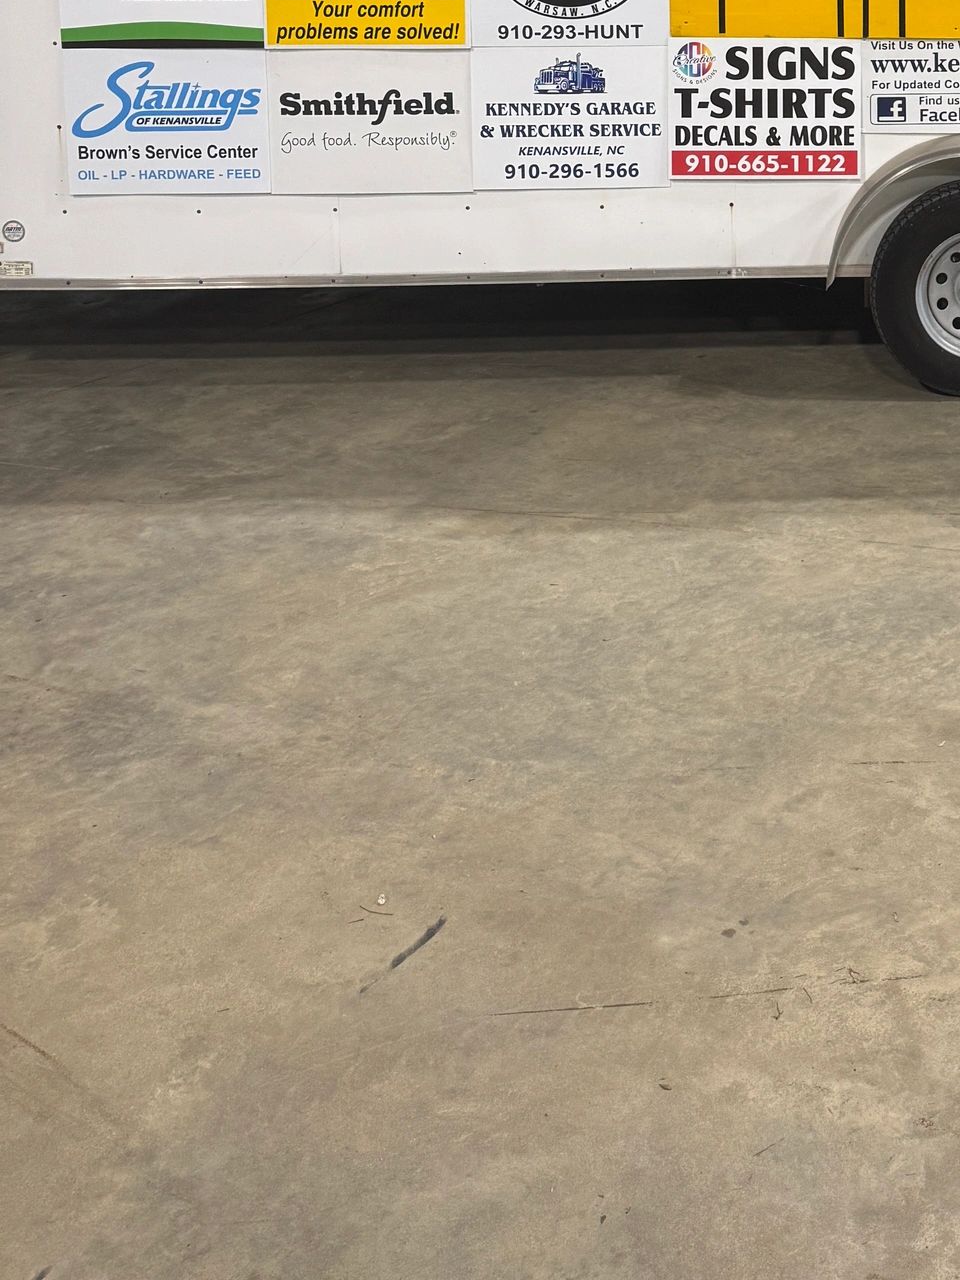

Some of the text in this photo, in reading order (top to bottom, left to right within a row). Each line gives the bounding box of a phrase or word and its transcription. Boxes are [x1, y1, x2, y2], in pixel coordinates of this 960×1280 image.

[312, 1, 424, 18] Your comfort
[277, 23, 460, 43] problems are solved!
[498, 24, 643, 40] 910-293-HUNT
[871, 42, 896, 50] Visit
[898, 42, 914, 50] Us
[917, 41, 934, 50] On
[937, 41, 954, 50] the
[726, 46, 855, 80] SIGNS
[872, 81, 890, 89] For
[893, 80, 941, 91] Updated
[72, 62, 261, 138] Stallings
[674, 88, 855, 119] T-SHIRTS
[919, 96, 943, 105] Find
[948, 97, 960, 105] us
[486, 102, 656, 116] KENNEDY'S GARAGE
[480, 124, 661, 138] & WRECKER SERVICE
[675, 125, 854, 146] DECALS & MORE
[78, 145, 258, 160] Brown's Service Center
[518, 146, 625, 157] KENANSVILLE, NC
[504, 163, 639, 179] 910-296-1566
[685, 155, 846, 173] 910-665-1122
